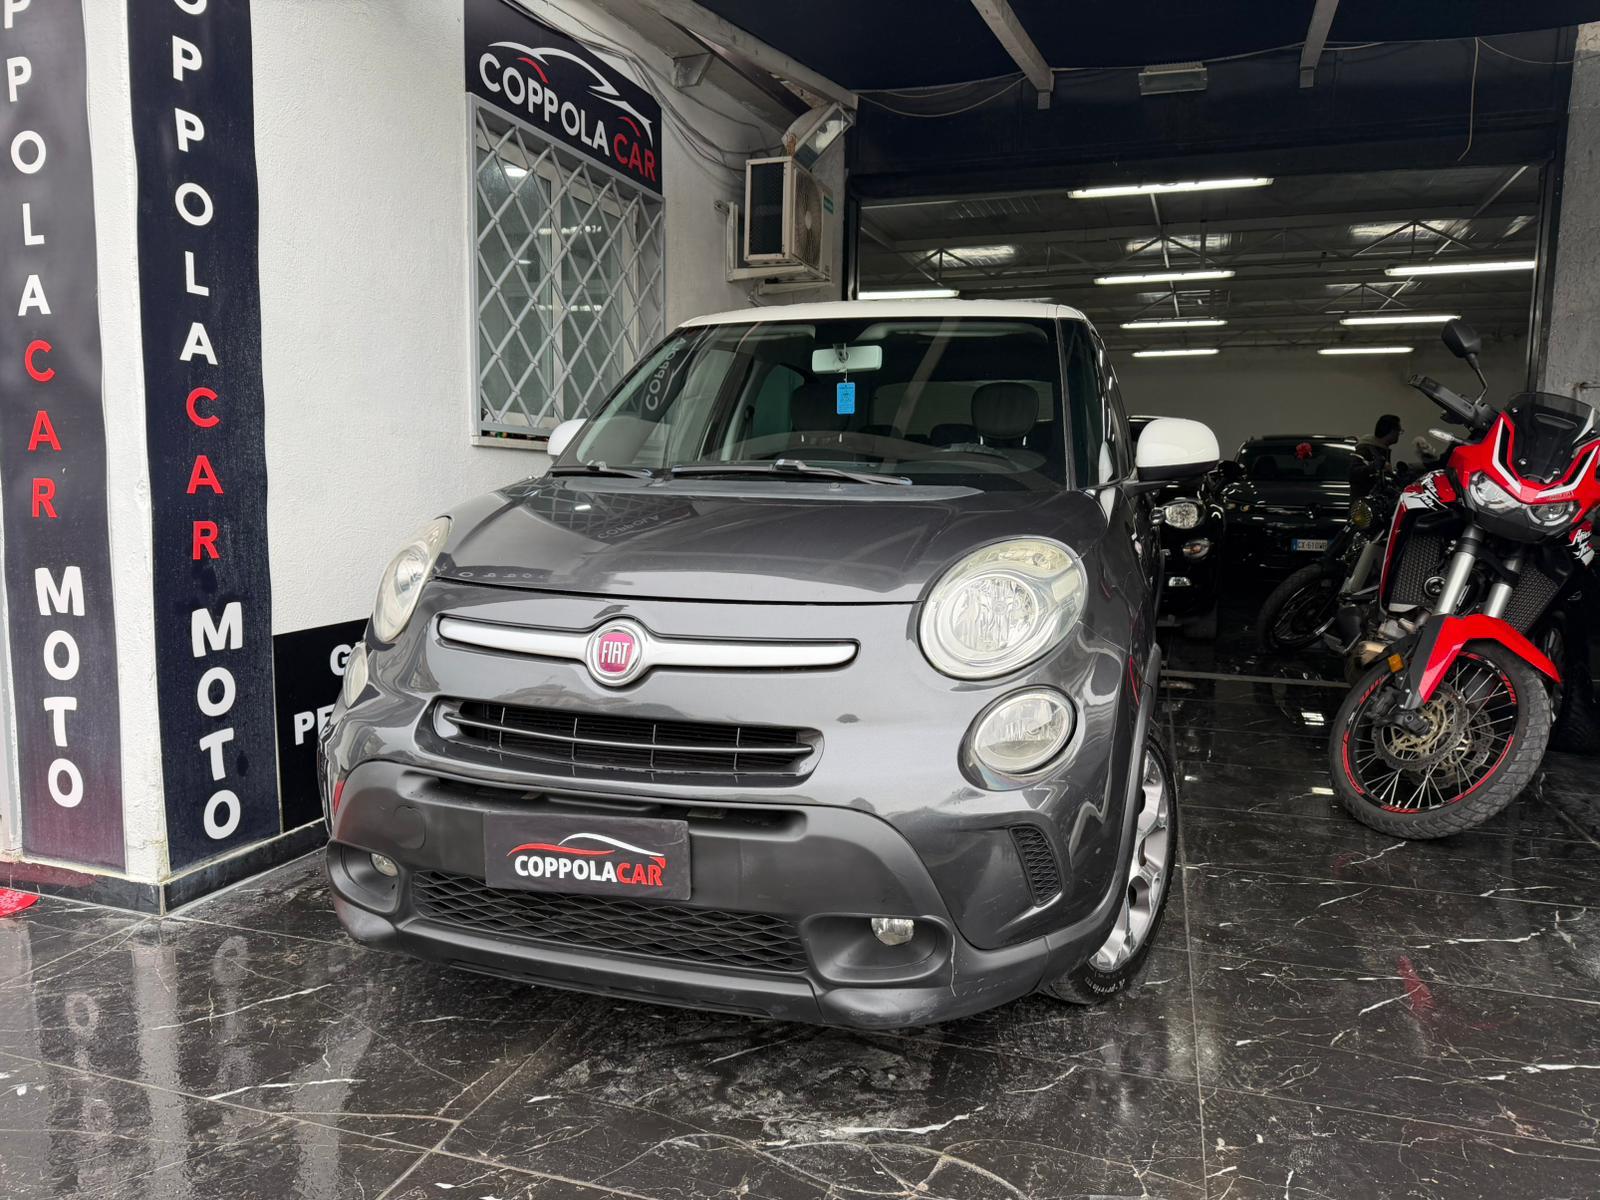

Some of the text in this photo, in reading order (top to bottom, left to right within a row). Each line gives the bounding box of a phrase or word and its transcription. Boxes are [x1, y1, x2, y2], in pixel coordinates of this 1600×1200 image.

[35, 566, 85, 808] MOTO
[191, 602, 243, 840] MOTO
[601, 641, 630, 664] FIAT
